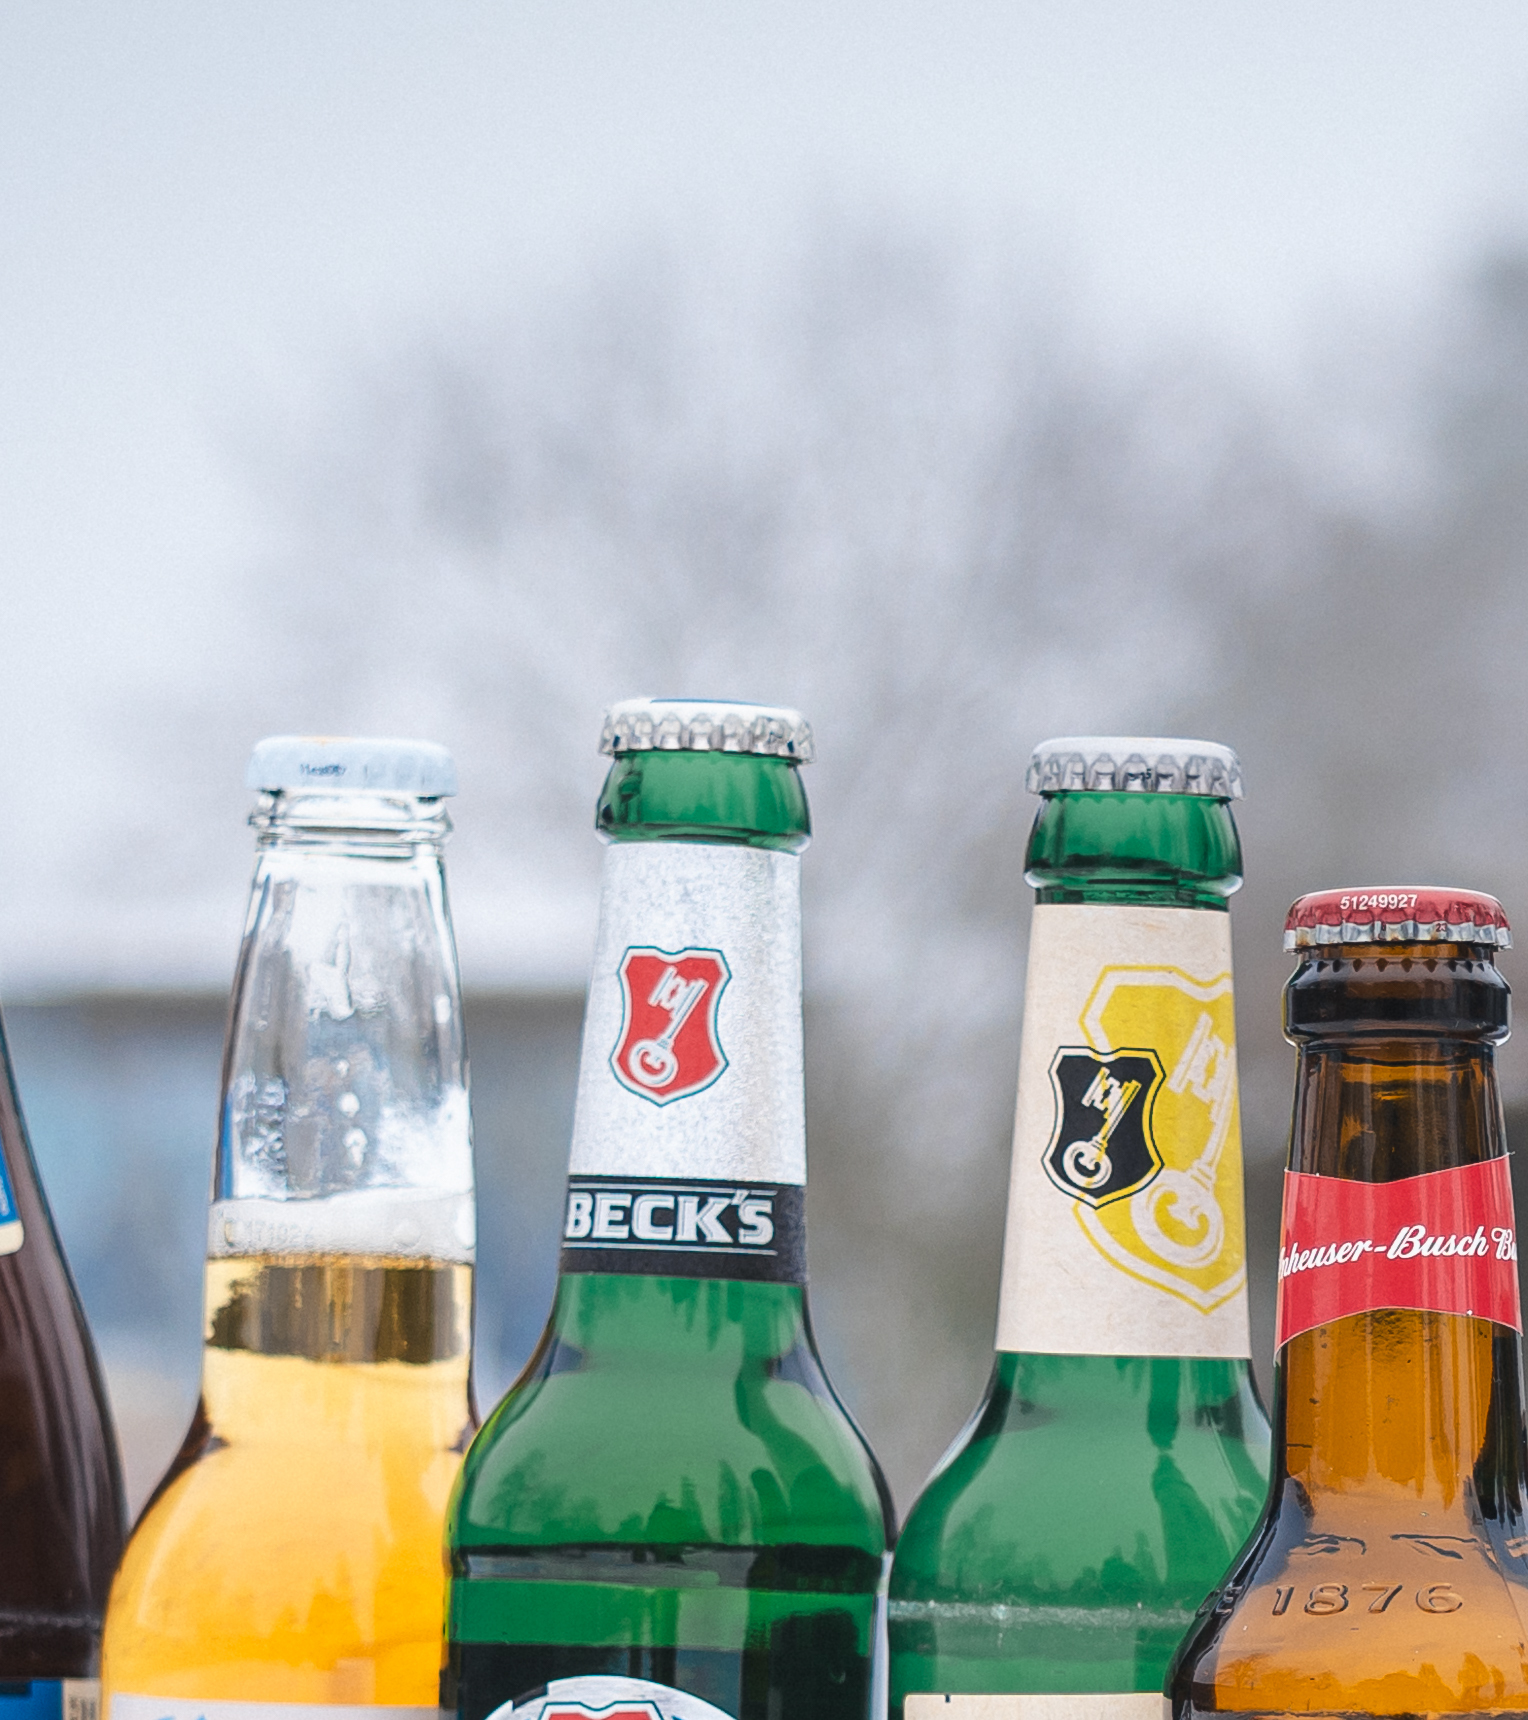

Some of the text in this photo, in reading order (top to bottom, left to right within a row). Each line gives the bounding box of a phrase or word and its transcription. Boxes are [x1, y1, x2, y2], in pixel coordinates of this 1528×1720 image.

[1340, 894, 1418, 911] 51249927
[565, 1188, 775, 1247] BECK'S
[1278, 1225, 1489, 1283] nheuser-Busch
[1272, 1582, 1465, 1617] 1876
